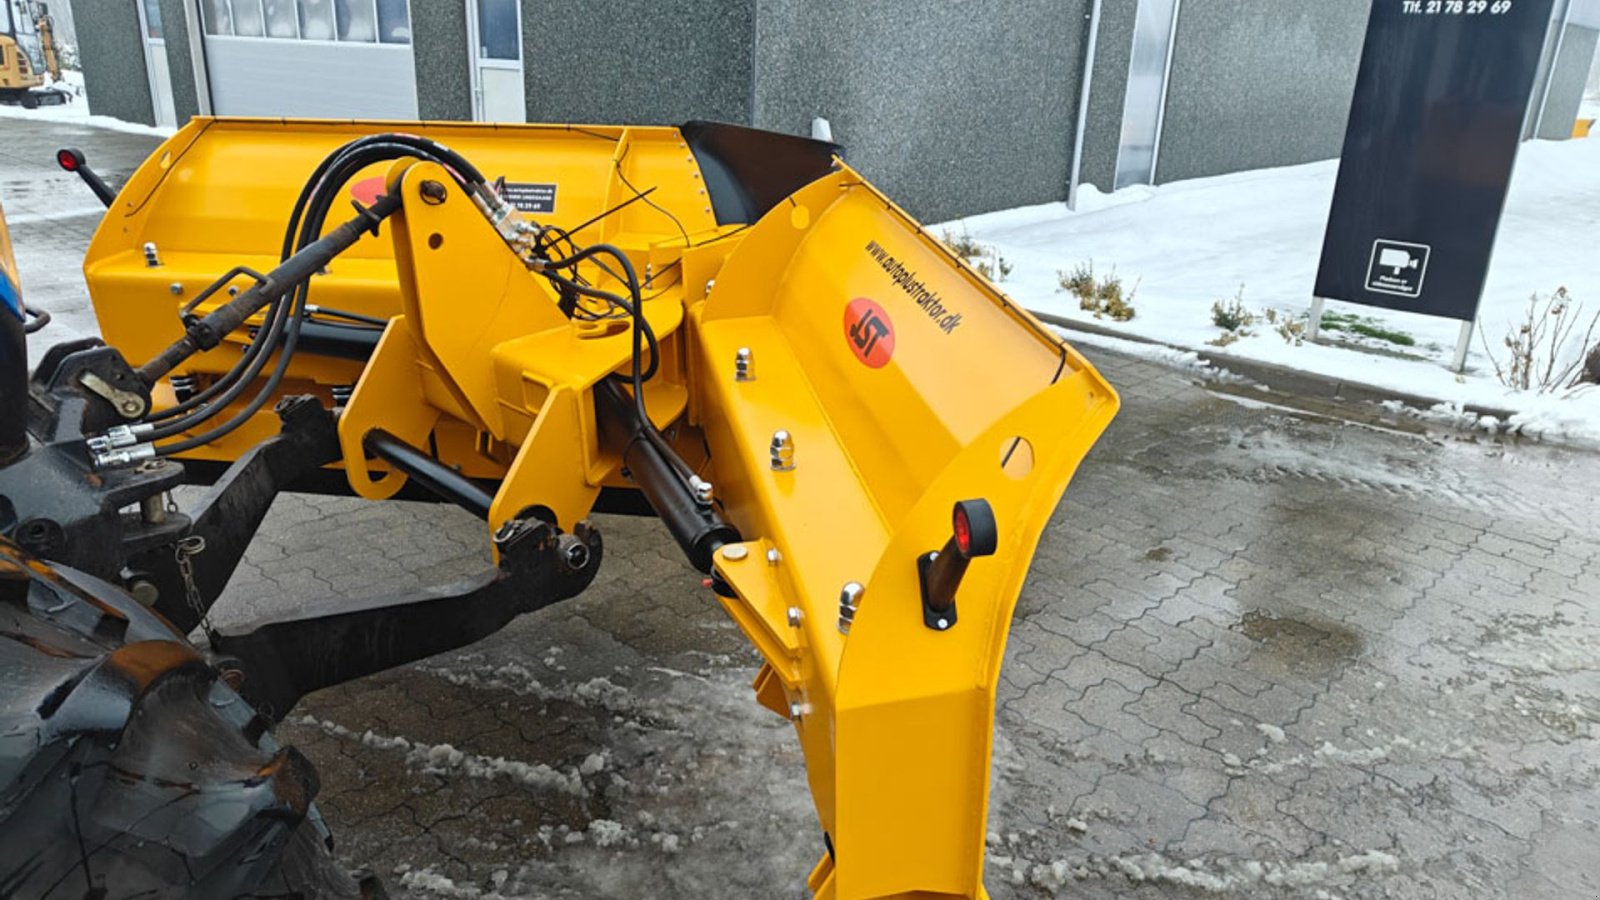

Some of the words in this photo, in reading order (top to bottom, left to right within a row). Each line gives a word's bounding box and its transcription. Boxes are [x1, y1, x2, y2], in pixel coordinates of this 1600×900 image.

[1403, 0, 1422, 14] Tlf.
[1426, 0, 1441, 14] 21
[1444, 0, 1463, 14] 78
[1466, 0, 1487, 14] 29
[1490, 0, 1512, 14] 69
[865, 240, 962, 335] www.autoplustraktor.dk
[849, 309, 889, 357] JST
